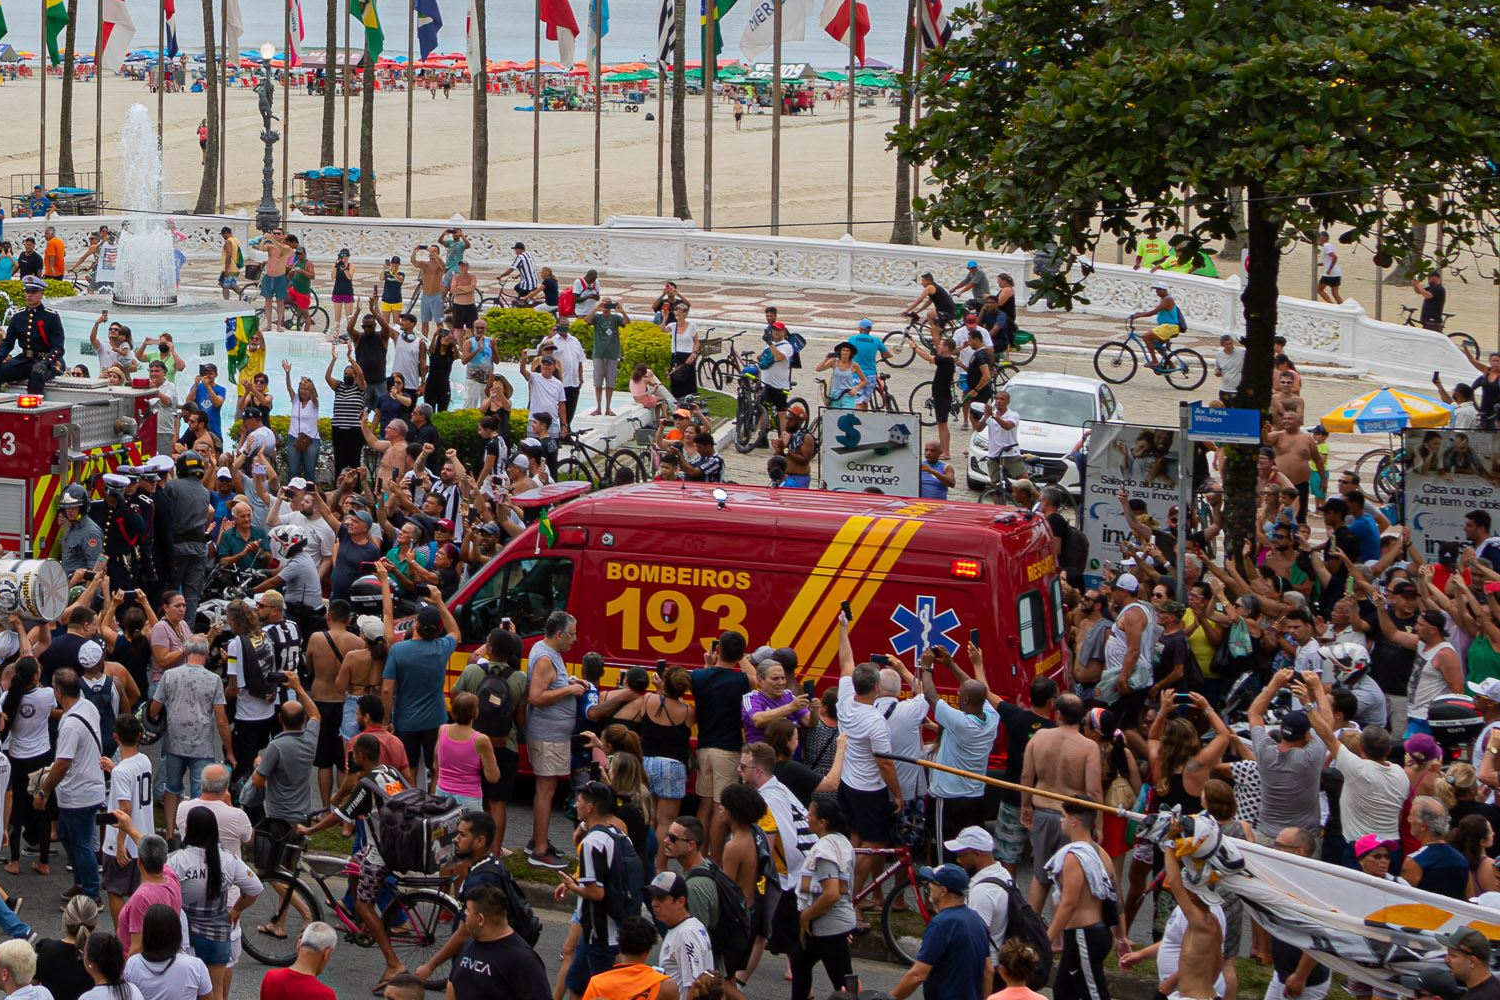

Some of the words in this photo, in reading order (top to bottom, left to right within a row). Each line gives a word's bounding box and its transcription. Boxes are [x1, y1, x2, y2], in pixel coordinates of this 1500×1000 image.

[847, 461, 894, 474] Comprar
[840, 474, 854, 482] ou
[858, 474, 900, 486] vender?
[1132, 488, 1150, 498] seu
[1422, 483, 1448, 494] Casa
[1468, 486, 1494, 498] apê?
[1412, 495, 1437, 506] Aqui
[1440, 496, 1462, 507] tem
[1464, 500, 1477, 508] os
[606, 562, 750, 590] BOMBEIROS
[1027, 554, 1054, 582] RESGATE
[606, 587, 750, 654] 193
[280, 646, 300, 672] 10
[137, 772, 152, 809] 10
[460, 956, 491, 976] RVCA
